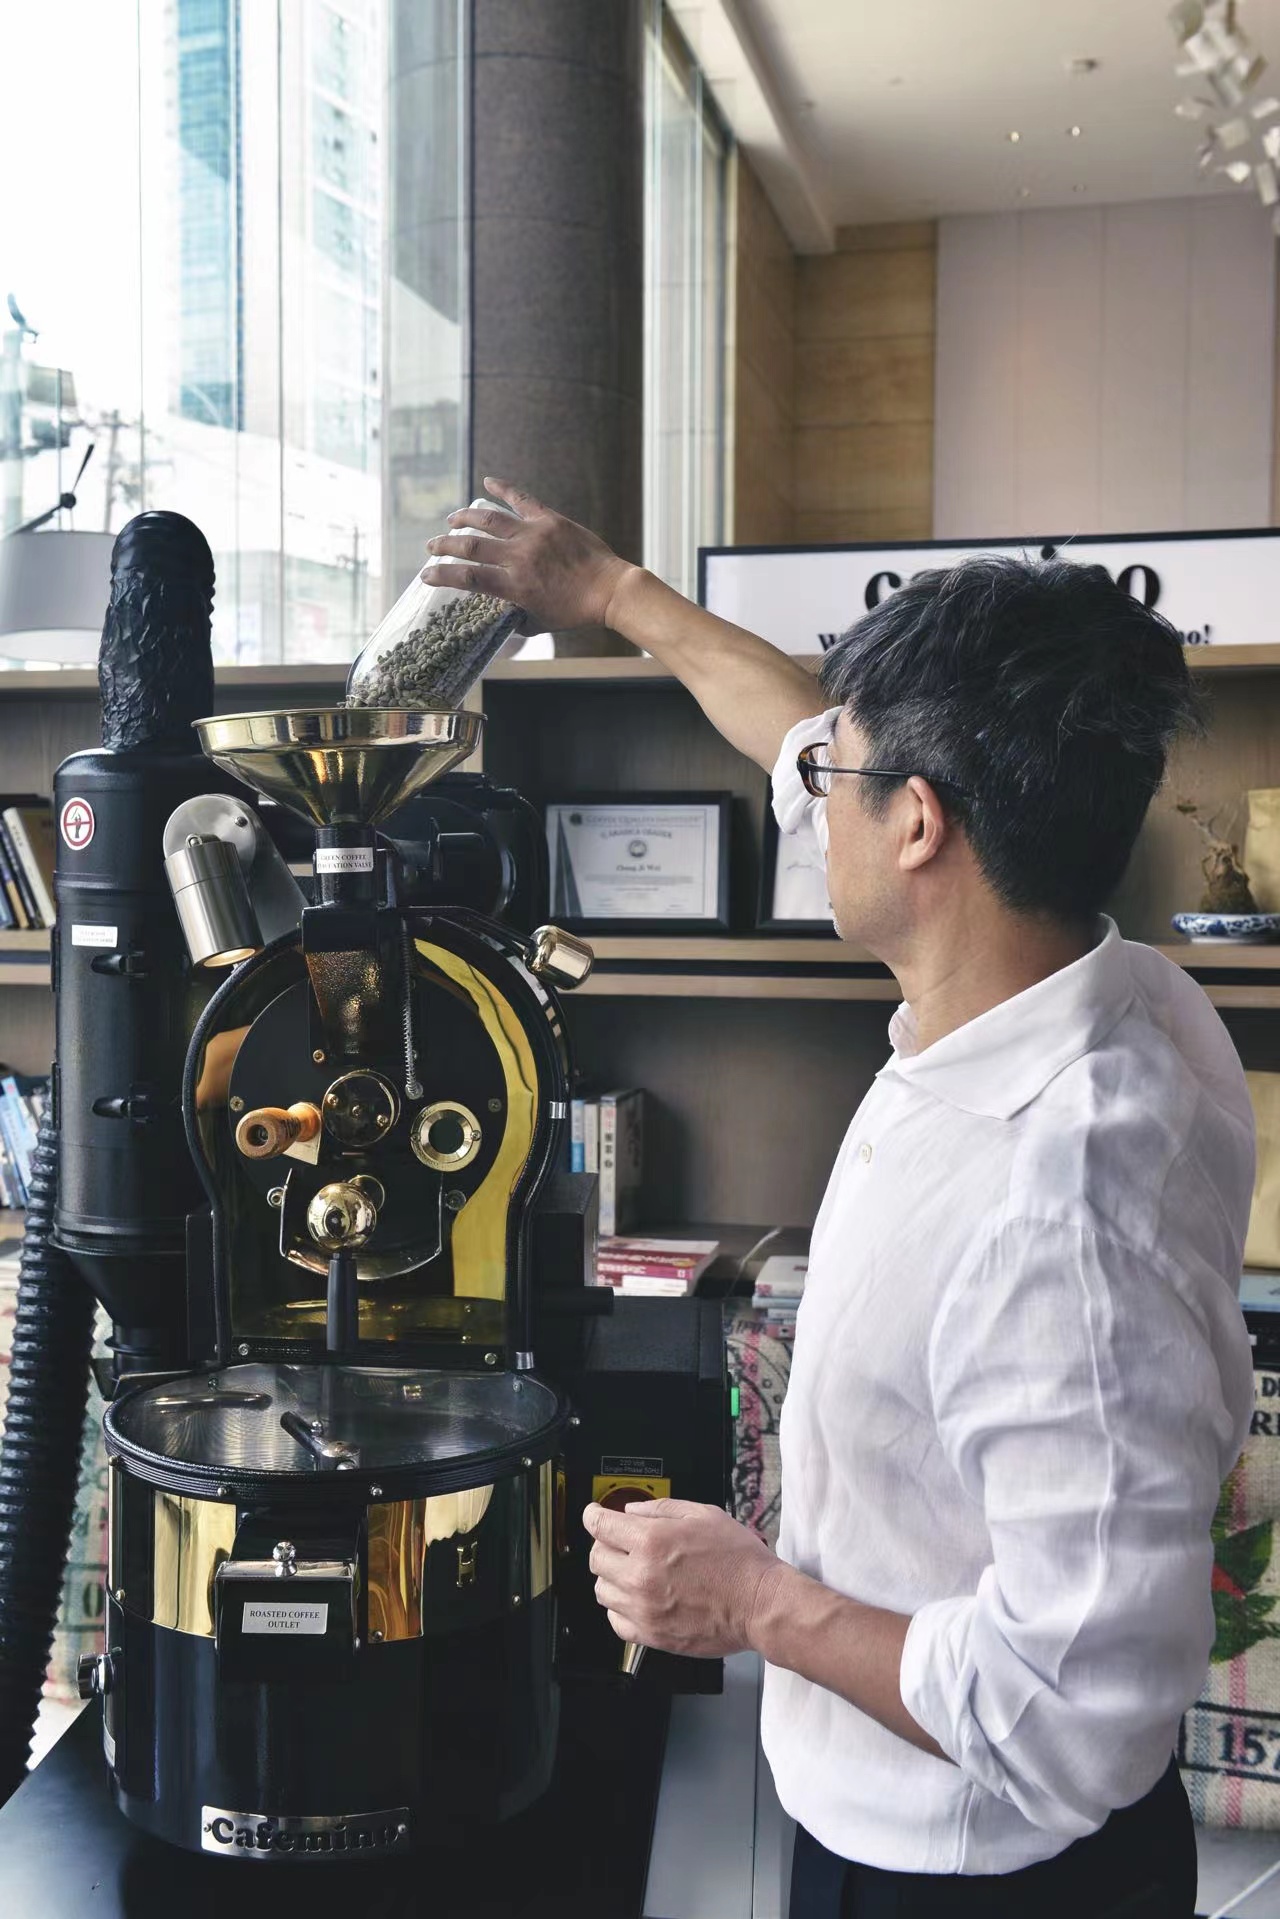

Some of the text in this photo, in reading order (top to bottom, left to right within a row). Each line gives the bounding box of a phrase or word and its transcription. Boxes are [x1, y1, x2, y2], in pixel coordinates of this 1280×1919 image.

[249, 1610, 320, 1619] ROASTED COFFEE
[268, 1621, 300, 1629] OUTLET
[211, 1816, 400, 1853] Cafemino
